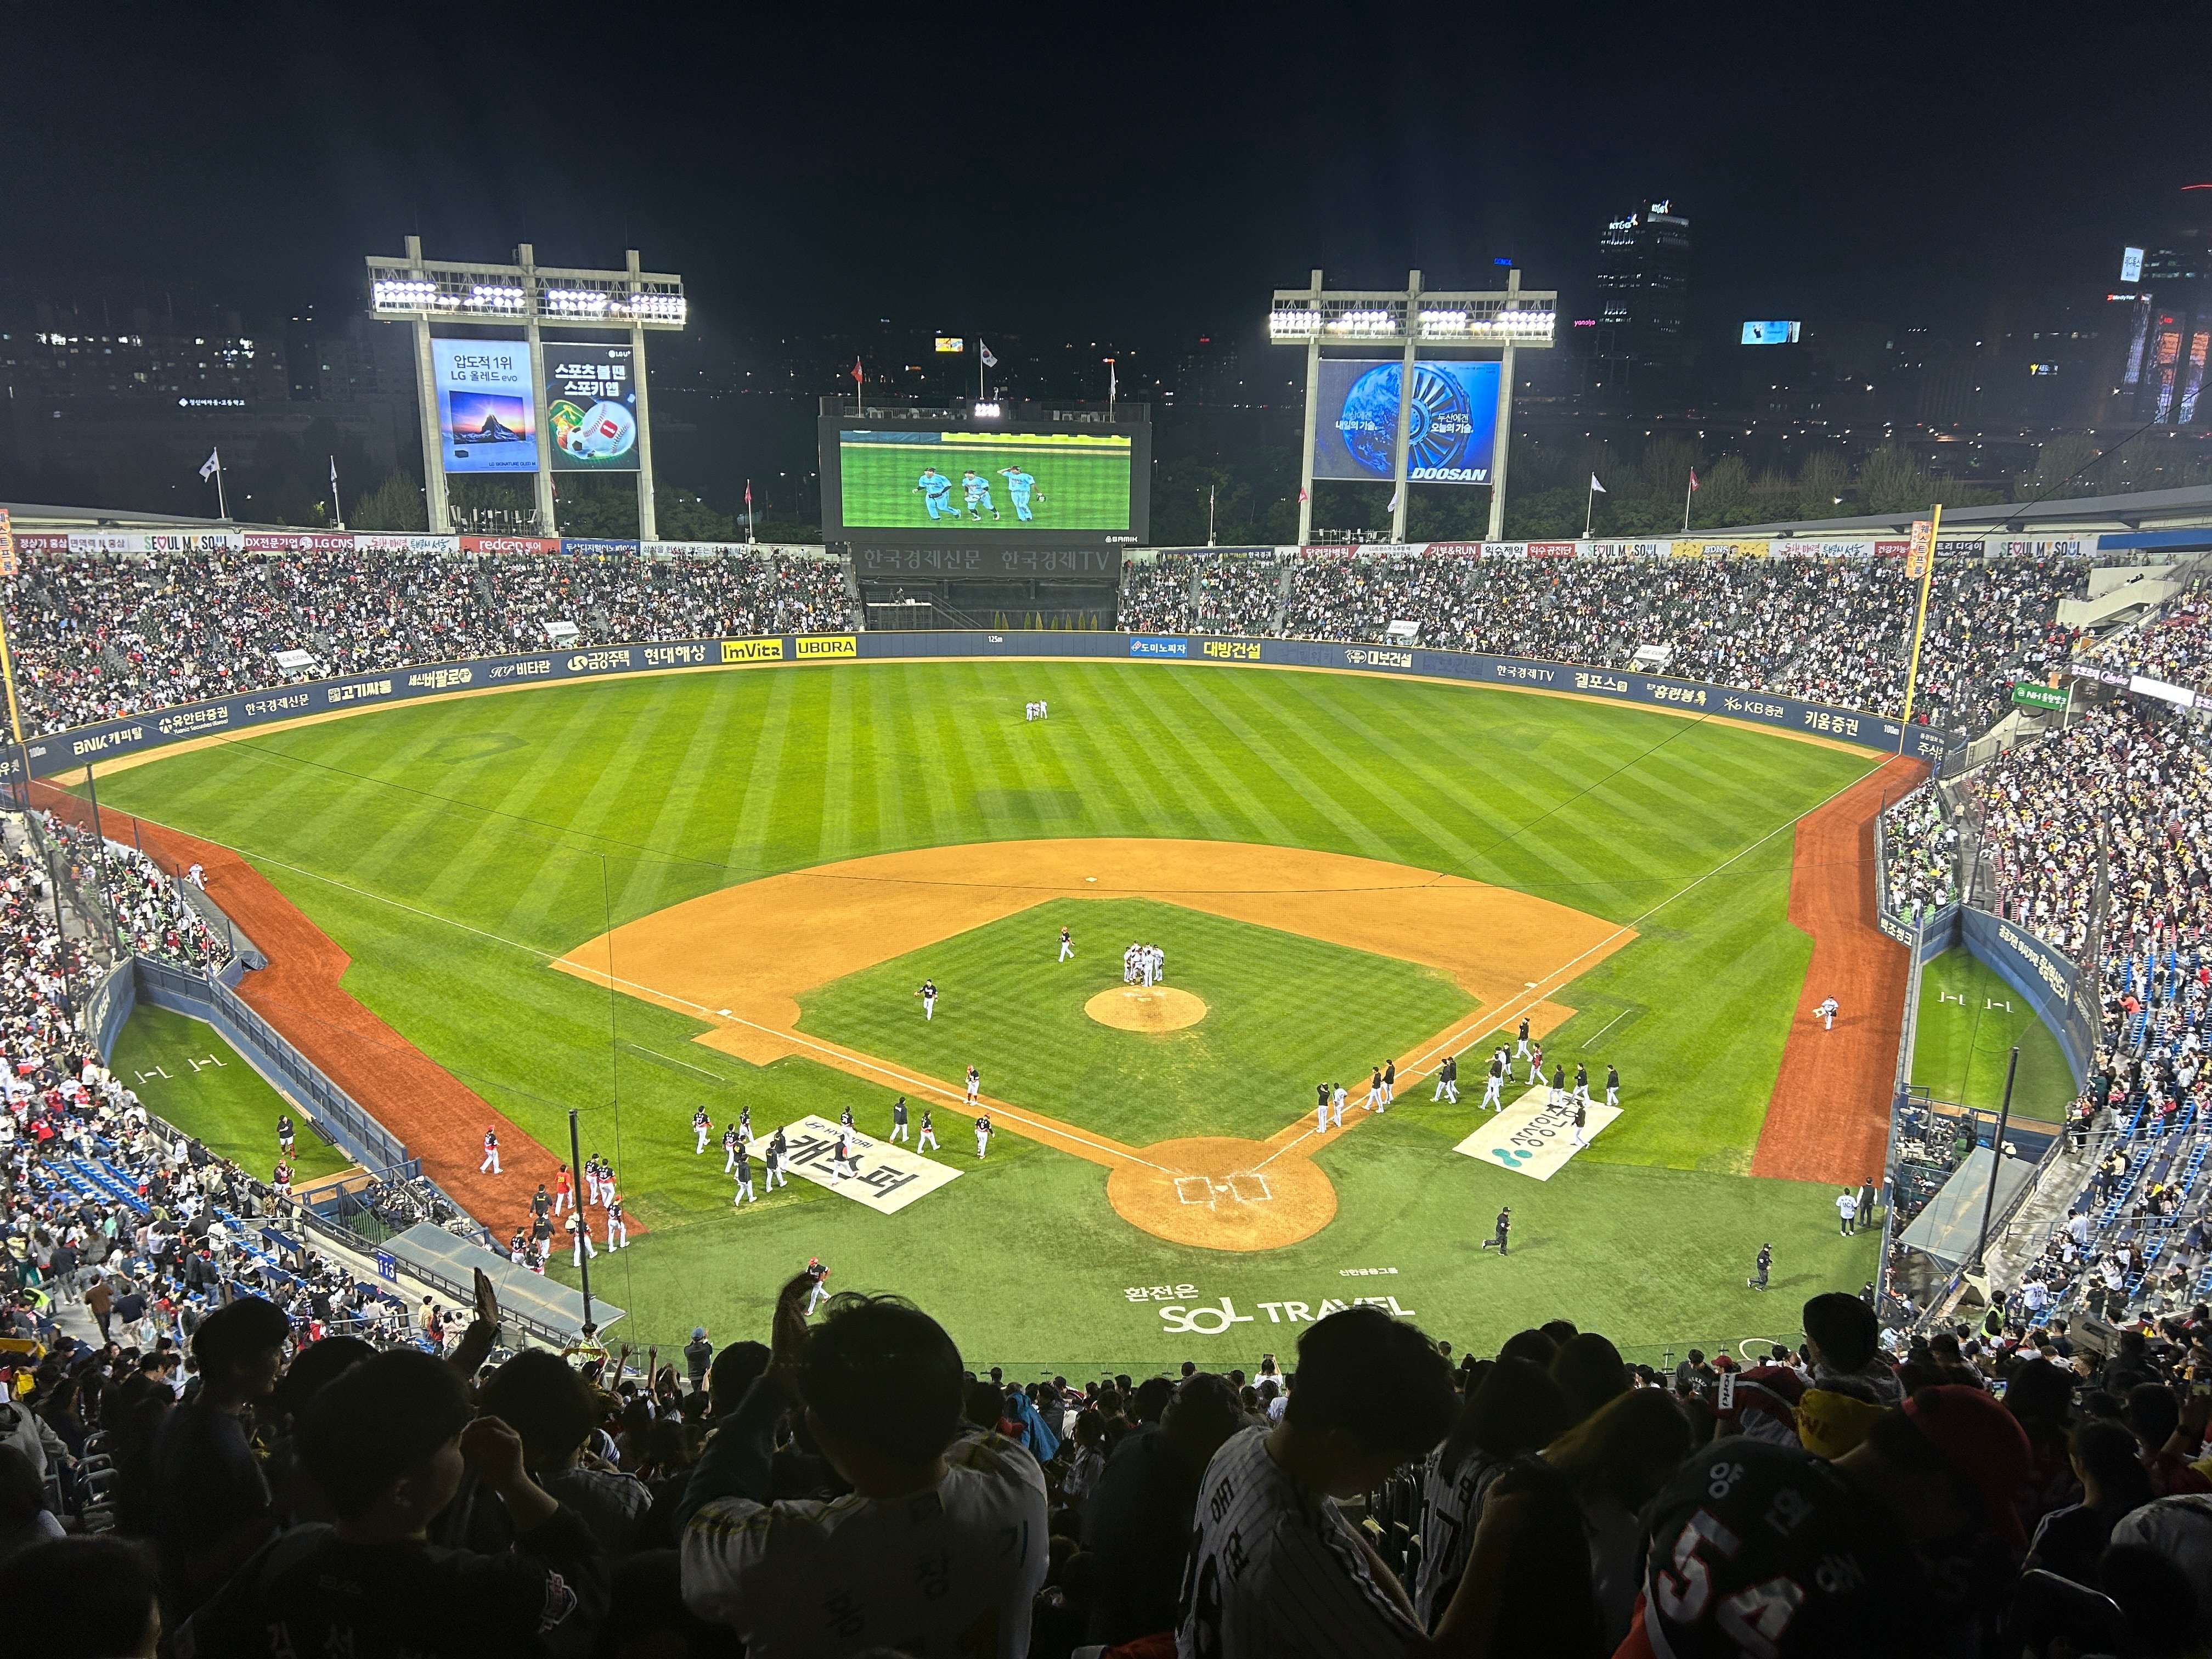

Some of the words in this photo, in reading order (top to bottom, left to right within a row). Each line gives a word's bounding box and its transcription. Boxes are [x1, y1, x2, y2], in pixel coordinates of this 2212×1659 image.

[454, 356, 490, 369] 압도적
[494, 356, 511, 370] 1위
[451, 371, 466, 381] LG
[470, 371, 500, 382] 올레드
[555, 364, 596, 379] 스포츠
[564, 381, 604, 396] 스포키
[606, 381, 619, 396] 앱
[1437, 413, 1469, 422] 두산에겐
[1335, 420, 1358, 431] 내일의
[1431, 423, 1454, 433] 오늘의
[1411, 467, 1488, 481] DOOSAN
[144, 535, 179, 550] SEOUL
[245, 537, 298, 548] DX전문기업
[315, 538, 330, 548] LG
[332, 537, 354, 549] CNS
[432, 539, 450, 551] 서울
[479, 540, 523, 550] redcap
[526, 542, 541, 550] 투어
[1845, 544, 1864, 555] 서울
[2000, 541, 2033, 556] SEOUL
[2055, 541, 2081, 556] SOUL
[1306, 548, 1348, 557] 달려라병원
[1431, 546, 1476, 555] 기부&RUN
[1486, 546, 1523, 555] 익수제약
[1588, 545, 1615, 556] SEOUL
[865, 549, 981, 569] 한국경제신문
[1001, 550, 1109, 571] 한국경제TV
[798, 641, 854, 653] UBORA
[988, 635, 1002, 644] 125m
[644, 645, 706, 665] 현대해상
[1141, 643, 1186, 654] 도미노피자
[1203, 641, 1261, 659] 대방건설
[1639, 649, 1667, 657] LGE.COM
[588, 650, 629, 670] 금강주택
[1368, 651, 1412, 668] 대보건설
[517, 660, 550, 675] 비타란
[1497, 665, 1555, 682] 한국경제TV
[409, 669, 460, 689] 세신버팔로
[1575, 673, 1617, 691] 겔포스
[341, 680, 392, 701] 고기싸롱
[1655, 685, 1695, 703] 홈런볼
[2026, 691, 2041, 700] NH
[245, 693, 309, 716] 한국경제신문
[1745, 701, 1763, 714] KB
[1765, 704, 1784, 718] 증권
[173, 706, 228, 727] 유안타증권
[1805, 710, 1859, 737] 키움증권
[1884, 723, 1899, 736] 100m
[73, 736, 109, 755] BNK
[109, 726, 143, 744] 캐피탈
[1881, 917, 1913, 946] 백조씽크
[785, 1135, 919, 1199] 캐스퍼
[379, 1260, 394, 1278] 113
[1339, 1267, 1398, 1276] 신한금융그룹
[1125, 1284, 1199, 1302] 환전은
[1159, 1296, 1254, 1334] SOL
